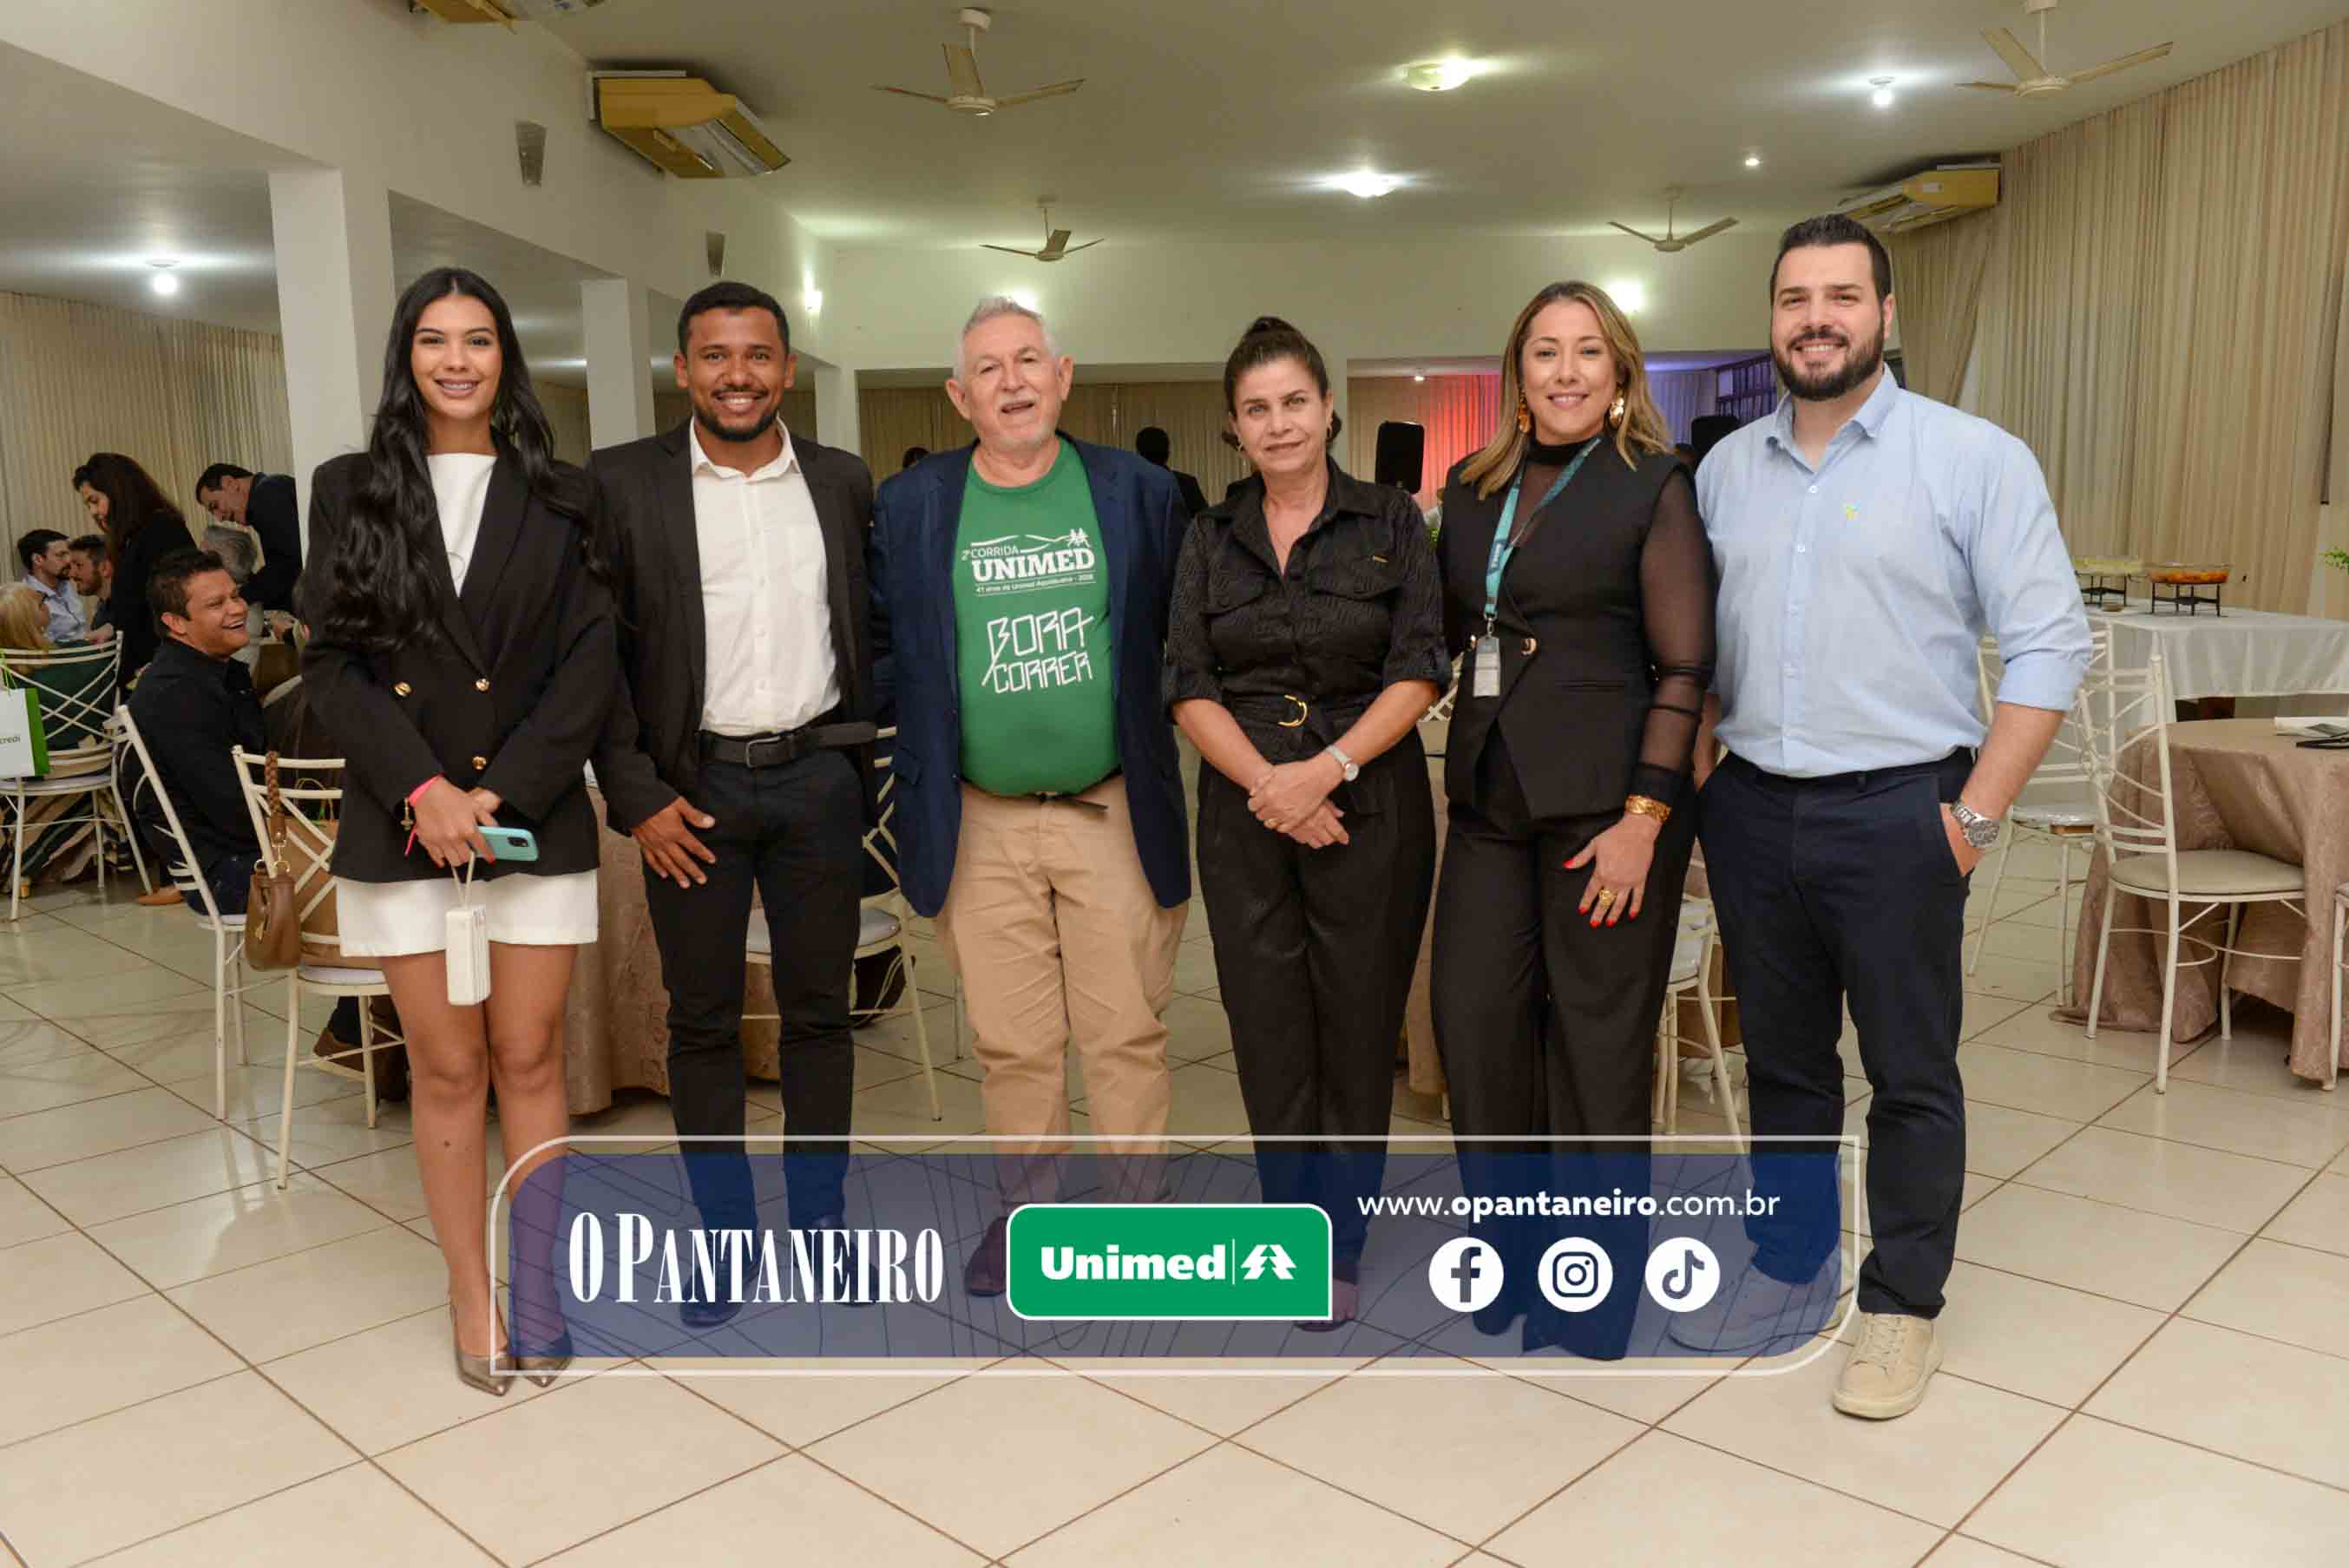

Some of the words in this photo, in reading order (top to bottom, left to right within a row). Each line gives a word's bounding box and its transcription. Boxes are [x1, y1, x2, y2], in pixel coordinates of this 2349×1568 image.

[971, 545, 1019, 558] CORRIDA
[971, 548, 1095, 581] UNIMED
[993, 651, 1092, 693] CORRER
